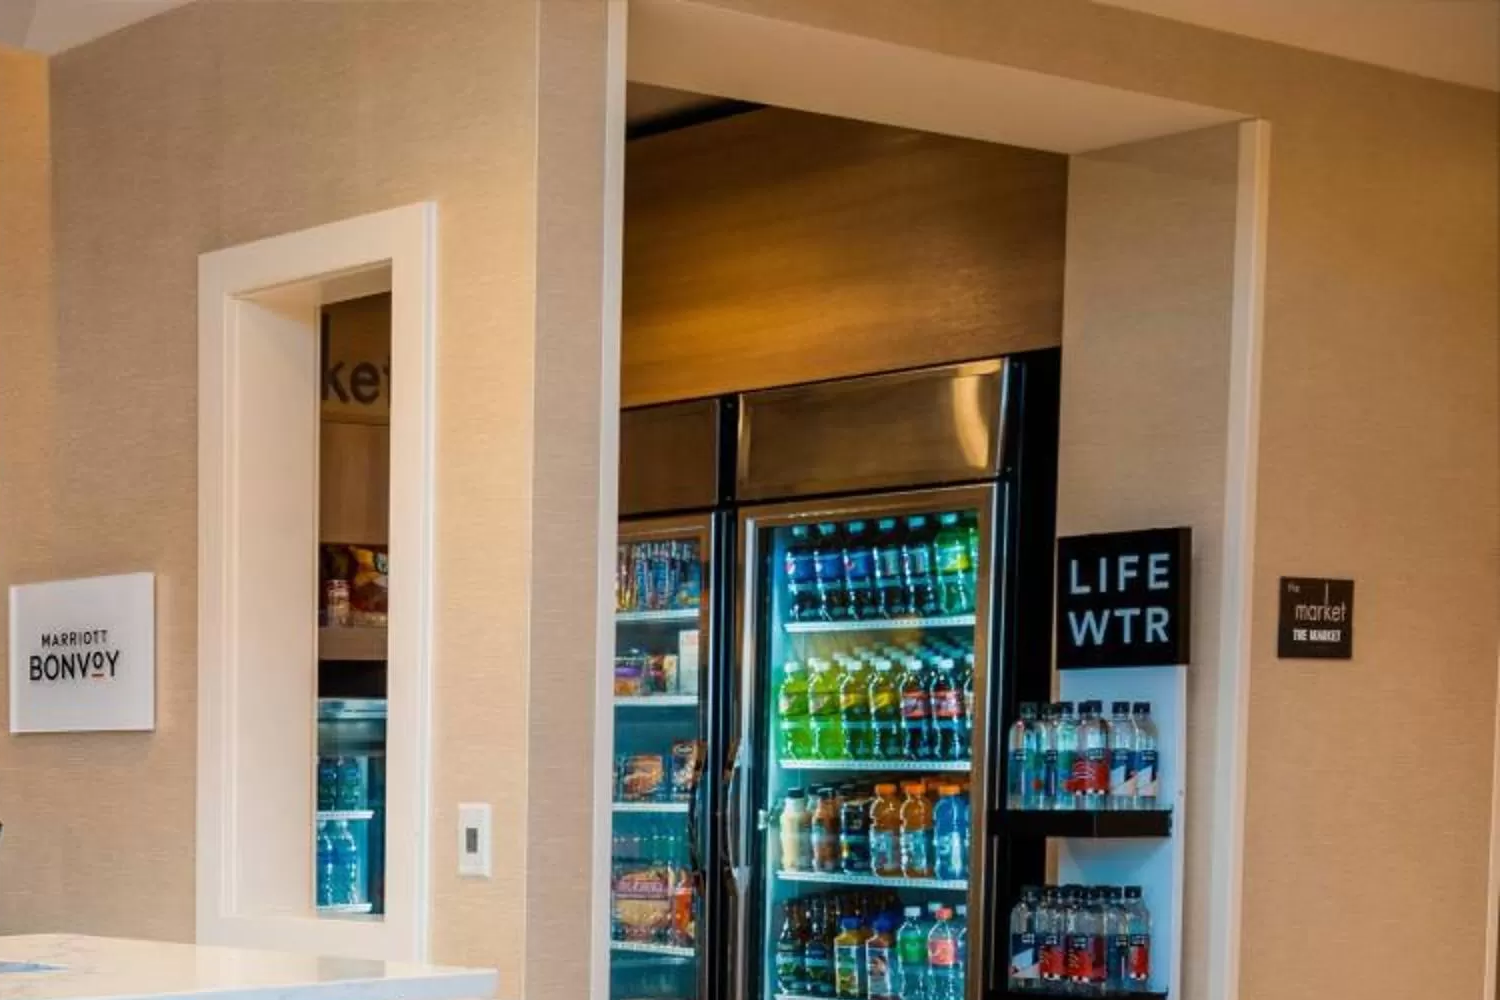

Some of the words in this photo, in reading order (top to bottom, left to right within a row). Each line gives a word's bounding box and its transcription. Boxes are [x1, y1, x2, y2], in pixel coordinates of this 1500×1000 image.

[1069, 551, 1171, 596] LIFE
[41, 629, 108, 648] MARRIOTT
[1067, 605, 1171, 648] WTR
[1292, 628, 1308, 641] THE
[29, 650, 120, 681] BONVOY
